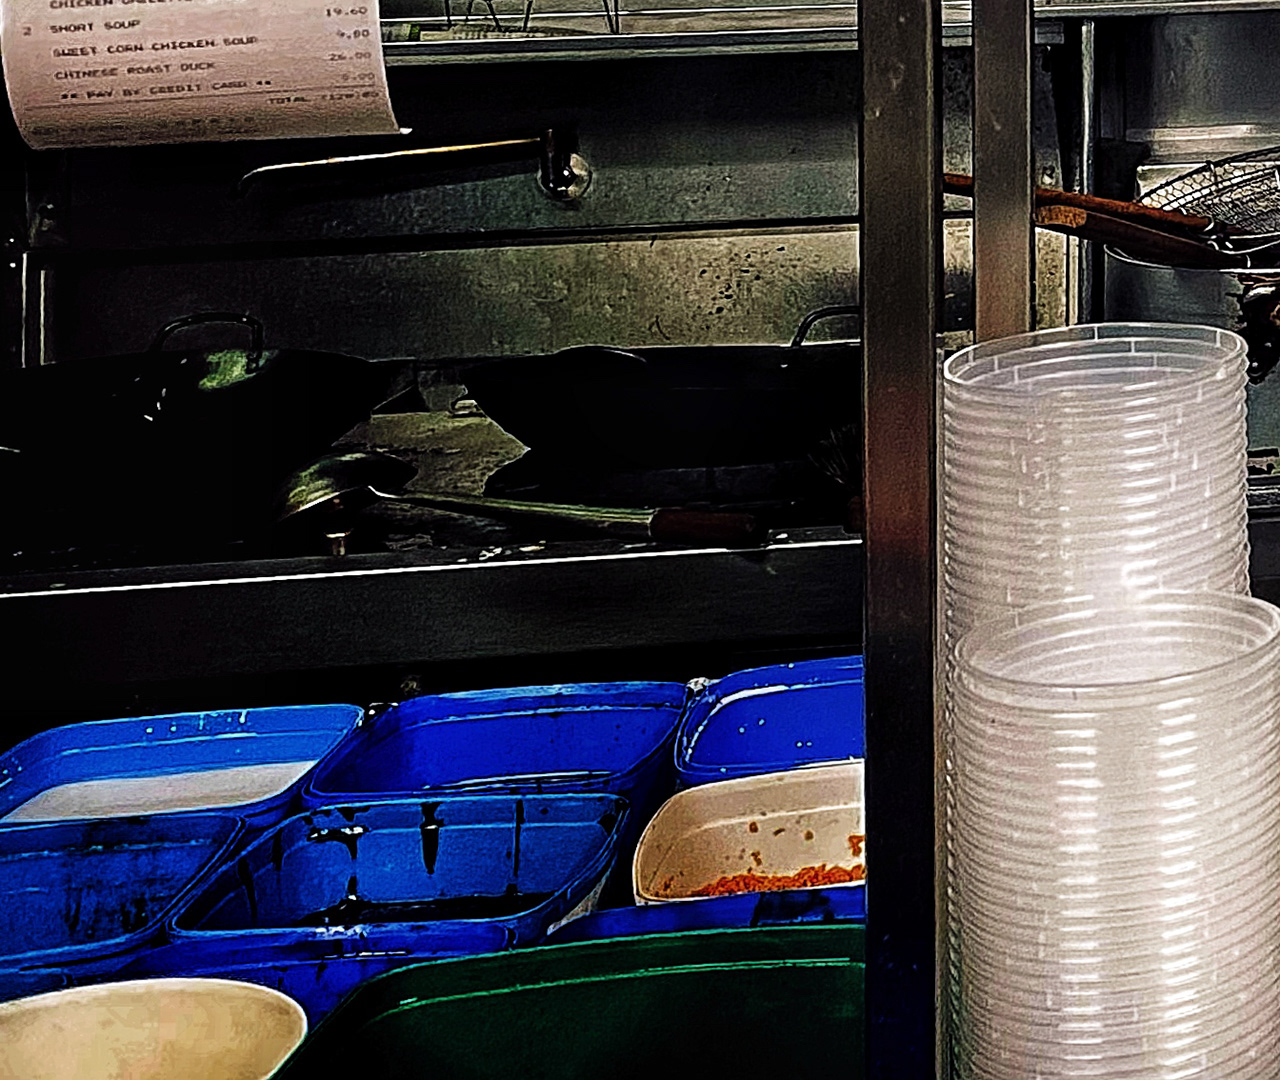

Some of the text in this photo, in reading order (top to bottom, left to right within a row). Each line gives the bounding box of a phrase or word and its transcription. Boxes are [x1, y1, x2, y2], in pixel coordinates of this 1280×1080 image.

[23, 26, 32, 36] 2
[50, 22, 94, 34] SHORT
[104, 19, 140, 30] SOUP
[53, 46, 98, 57] SWEET
[107, 43, 144, 54] CORN
[151, 39, 215, 51] CHICKEN
[223, 36, 258, 46] SOUP
[54, 68, 119, 80] CHINESE
[127, 65, 171, 76] ROAST
[180, 62, 216, 71] DUCK
[123, 87, 140, 97] BY
[150, 83, 202, 95] CREDIT
[212, 81, 247, 91] CARD
